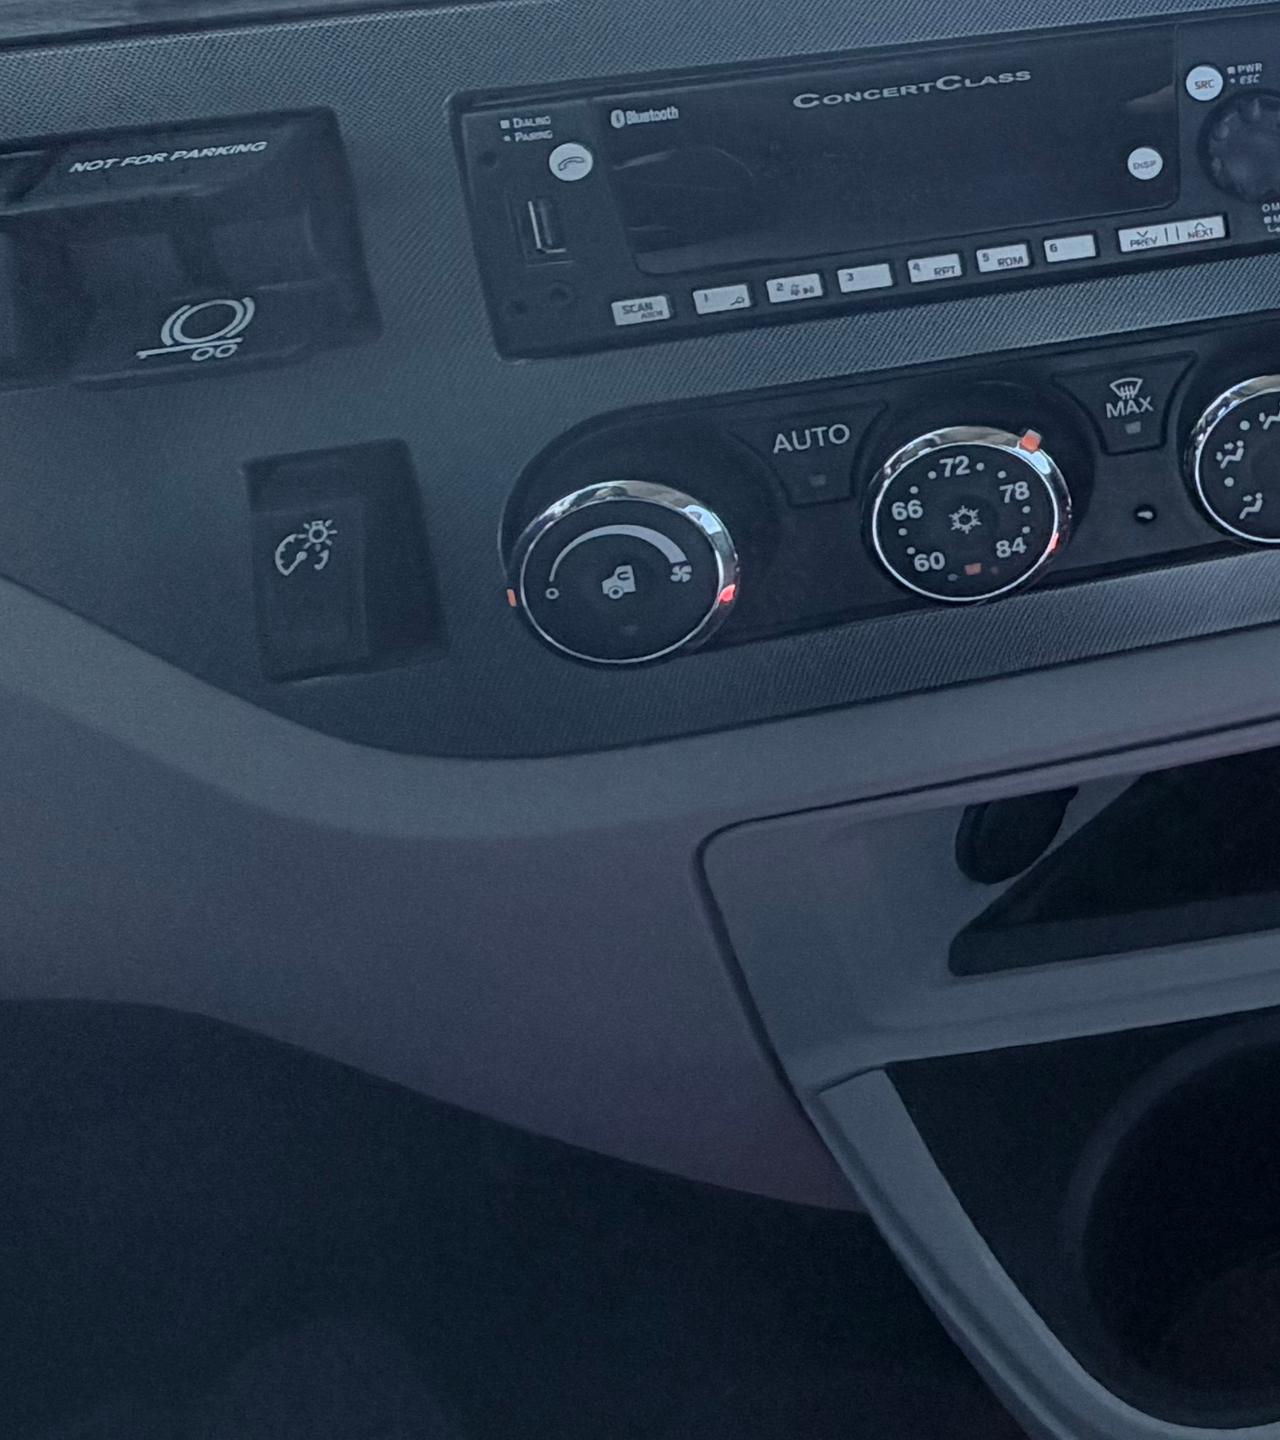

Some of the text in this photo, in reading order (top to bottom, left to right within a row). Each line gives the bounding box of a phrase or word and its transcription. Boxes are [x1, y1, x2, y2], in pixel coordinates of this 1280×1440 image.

[1236, 62, 1263, 74] PWR
[1194, 78, 1216, 91] SRC
[625, 106, 679, 126] Bluetooth
[69, 141, 268, 173] NOT FOR PARKING
[1128, 235, 1159, 249] PREV
[1187, 228, 1215, 240] NEXT
[1048, 243, 1059, 254] 6
[982, 252, 1025, 268] 5 RDM
[846, 272, 855, 282] 3
[911, 263, 957, 277] 4 RPT
[775, 282, 785, 292] 2
[621, 301, 654, 315] SCAN
[1105, 395, 1155, 419] MAX
[772, 422, 851, 455] AUTO
[939, 455, 971, 478] 72
[999, 480, 1031, 504] 78
[891, 499, 924, 521] 66
[995, 536, 1027, 559] 84
[913, 551, 946, 573] 60
